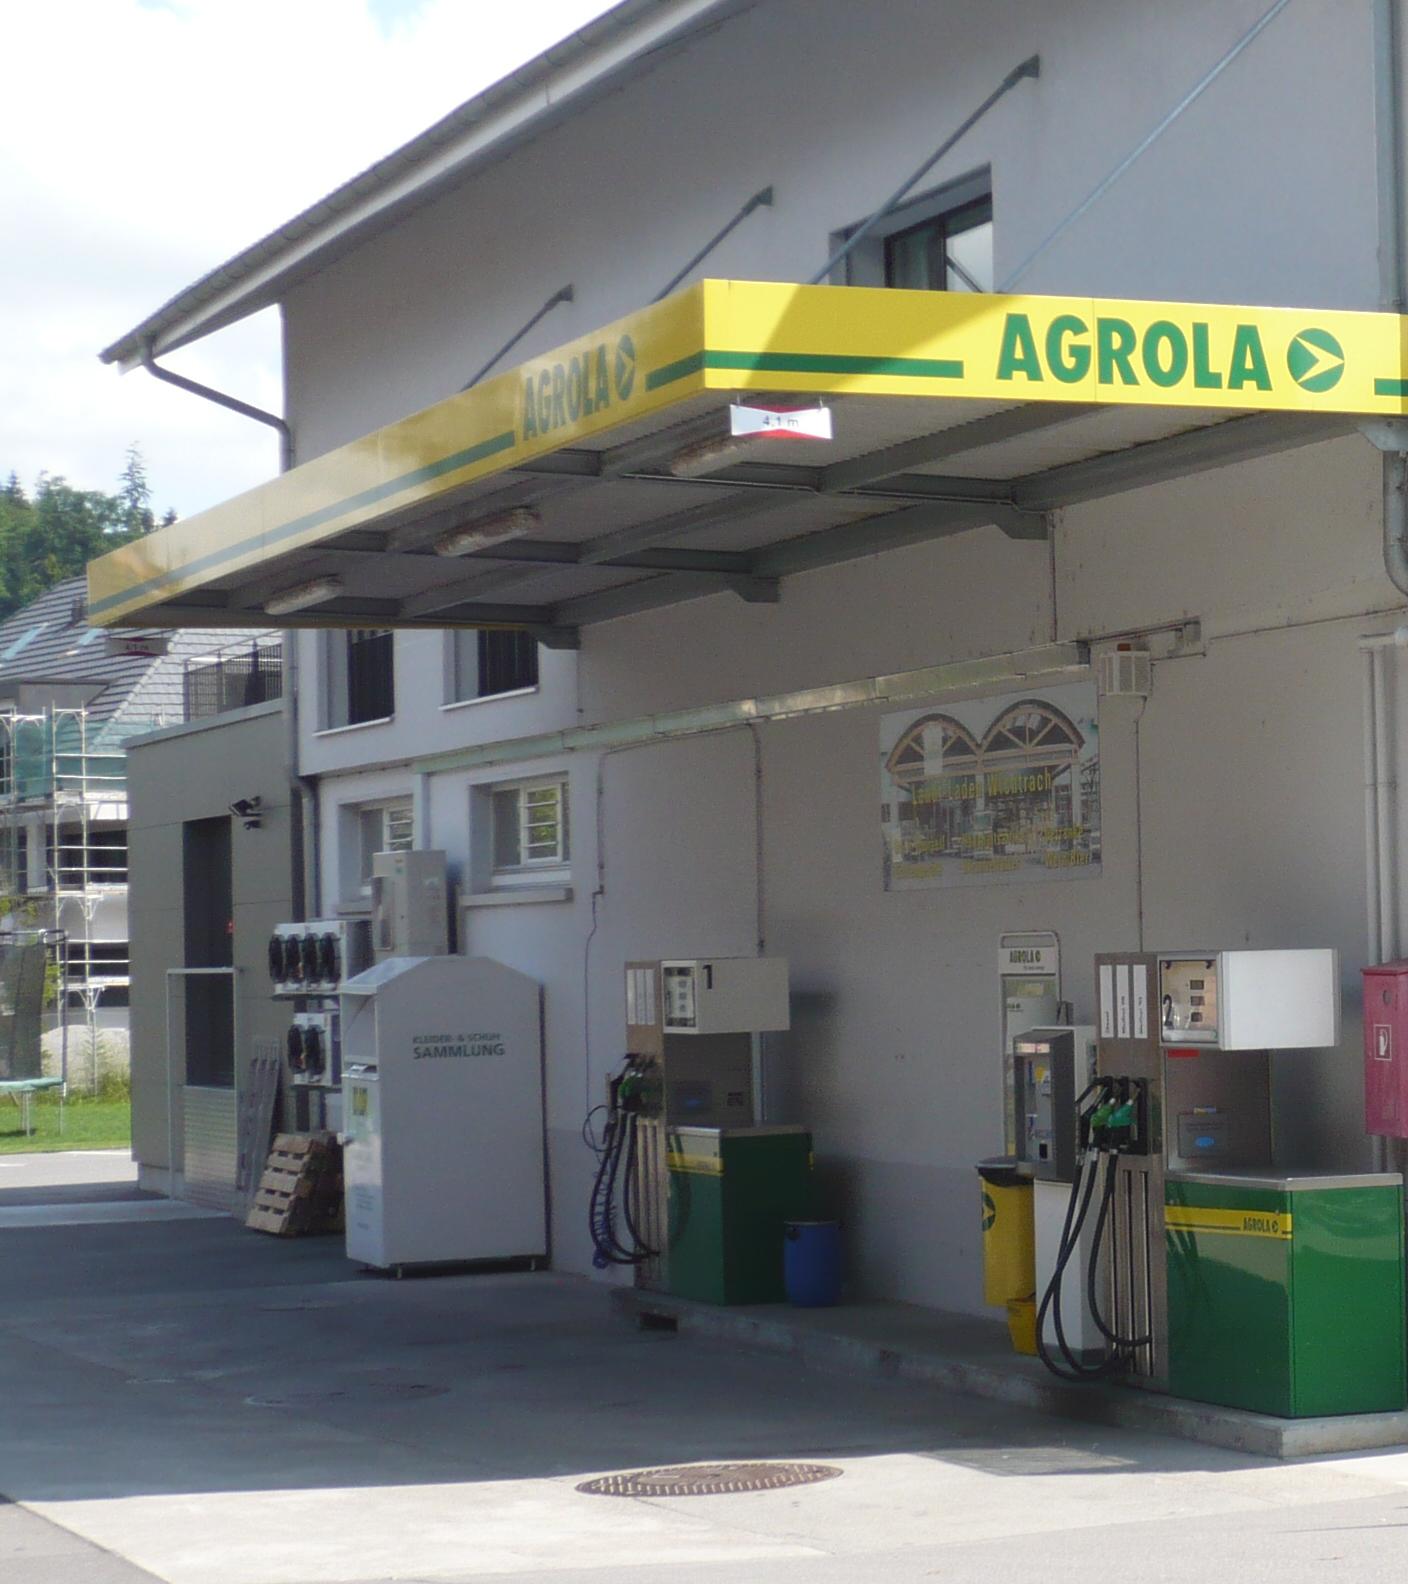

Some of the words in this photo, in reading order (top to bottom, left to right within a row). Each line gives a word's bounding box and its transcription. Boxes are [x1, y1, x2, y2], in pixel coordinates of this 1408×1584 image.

[995, 313, 1273, 391] AGROLA
[522, 343, 610, 441] AGROLA
[702, 964, 713, 990] 1
[413, 1042, 505, 1060] SAMMLUNG
[1242, 1216, 1271, 1234] AGROLA
